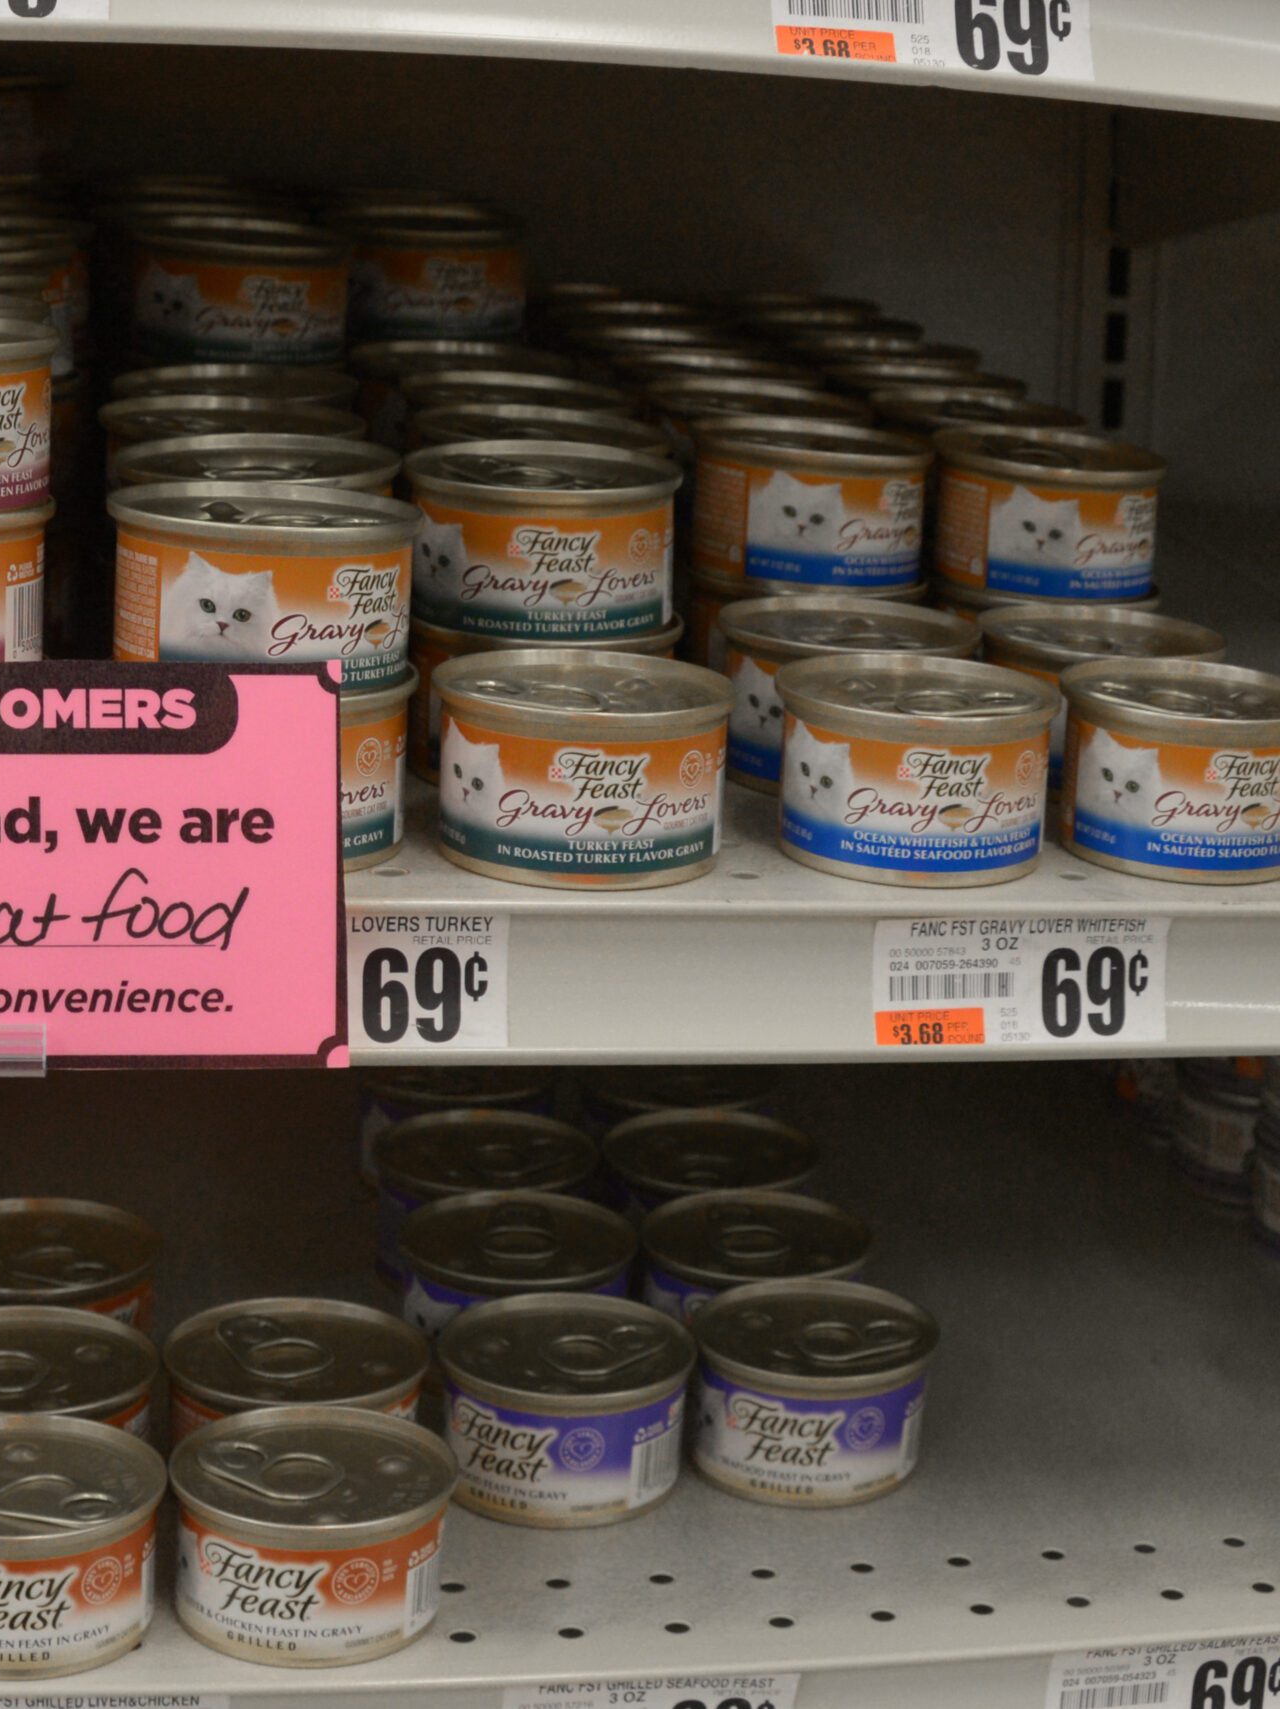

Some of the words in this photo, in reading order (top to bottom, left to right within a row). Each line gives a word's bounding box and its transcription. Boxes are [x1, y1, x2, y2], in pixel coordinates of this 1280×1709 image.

[789, 26, 816, 36] UNIT
[820, 28, 855, 39] PRICE
[910, 34, 930, 44] 525
[853, 41, 877, 51] PER
[911, 46, 932, 56] 018
[516, 529, 597, 554] Fancy
[527, 551, 595, 575] Feast
[336, 568, 399, 596] Fancy
[349, 592, 396, 619] Feast
[267, 614, 365, 656] Gravy
[558, 752, 648, 779] Fancy
[907, 751, 987, 781] Fancy
[566, 776, 645, 802] Feast
[920, 776, 985, 800] Feast
[496, 789, 593, 837] Gravy
[622, 793, 707, 837] Lovers
[845, 787, 940, 834] Gravy
[963, 793, 1037, 834] Lovers
[1151, 791, 1242, 832] Gravy
[75, 807, 162, 843] we
[179, 807, 275, 843] are
[498, 844, 512, 855] IN
[514, 847, 573, 863] ROASTED
[576, 852, 625, 864] TURKEY
[629, 849, 674, 864] FLAVOR
[676, 842, 704, 859] GRAVY
[569, 840, 618, 851] TURKEY
[621, 839, 655, 850] FEAST
[81, 867, 250, 951] food
[352, 916, 420, 933] LOVERS
[425, 916, 493, 932] TURKEY
[910, 922, 947, 937] FANC
[950, 921, 975, 936] FST
[980, 920, 1026, 935] GRAVY
[1029, 919, 1072, 934] LOVER
[1077, 918, 1146, 933] WHITEFISH
[412, 935, 453, 946] RETAIL
[456, 935, 493, 945] PRICE
[981, 938, 991, 951] 3
[996, 937, 1019, 950] OZ
[362, 947, 488, 1043] 69¢
[1042, 946, 1149, 1038] 69¢
[889, 1012, 916, 1022] UNIT
[917, 1011, 950, 1021] PRICE
[1000, 1008, 1018, 1017] 525
[892, 1022, 944, 1045] $3.68
[947, 1022, 969, 1031] PER
[948, 1033, 985, 1044] POUND
[455, 1402, 554, 1460] Fancy
[732, 1398, 844, 1446] Fancy
[466, 1436, 548, 1483] Feast
[745, 1431, 839, 1467] Feast
[205, 1542, 325, 1598] Fancy
[220, 1578, 320, 1622] Feast
[226, 1630, 297, 1652] GRILLED
[1144, 1657, 1151, 1666] 3
[1157, 1655, 1176, 1665] OZ
[610, 1692, 618, 1703] 3
[623, 1691, 646, 1702] OZ
